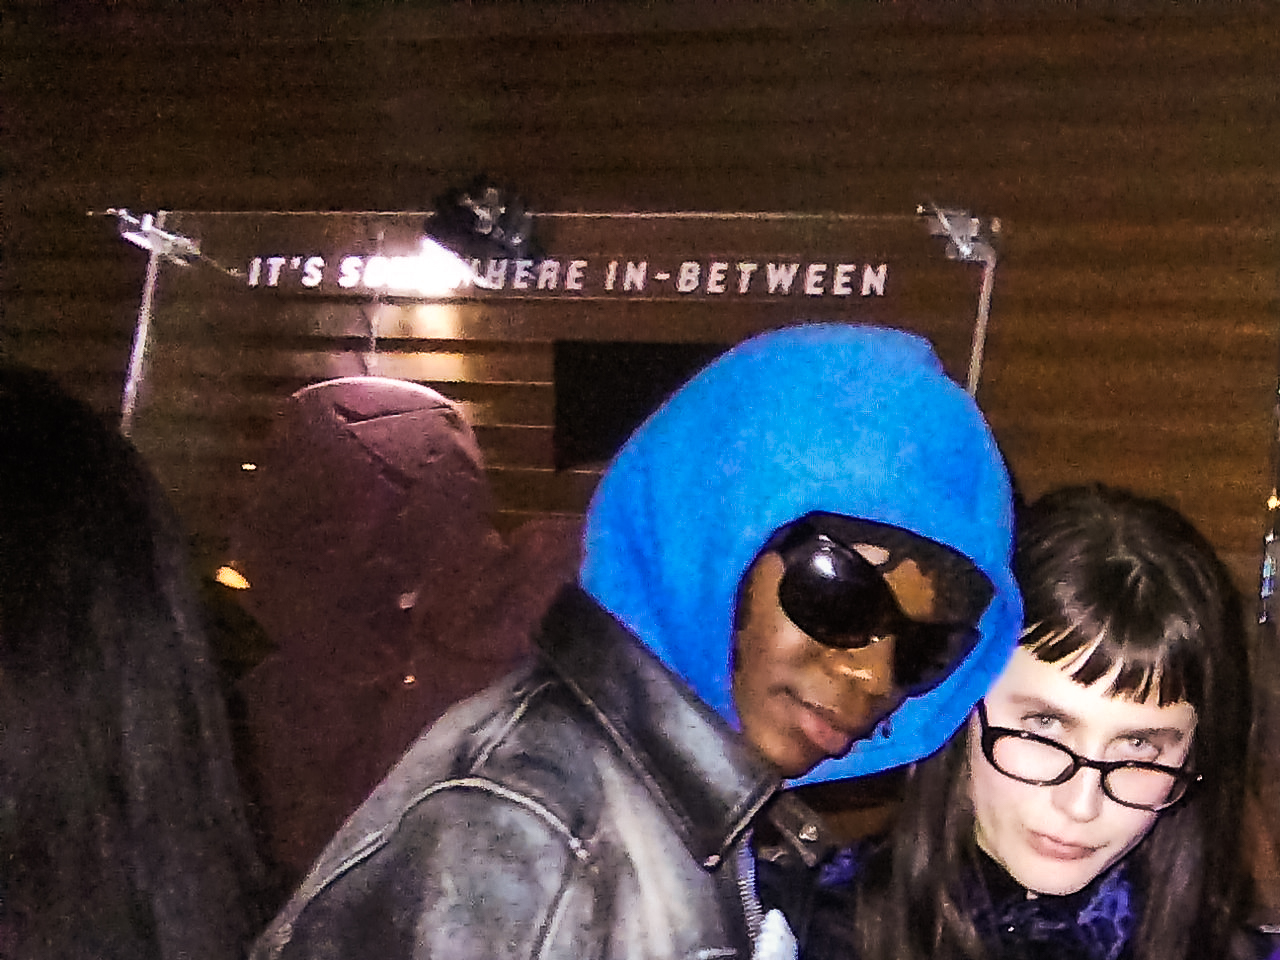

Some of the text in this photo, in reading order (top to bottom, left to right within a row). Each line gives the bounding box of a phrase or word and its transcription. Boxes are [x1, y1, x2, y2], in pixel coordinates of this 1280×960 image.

[248, 255, 888, 296] IT'S SOHERE IN-BETWEEN
